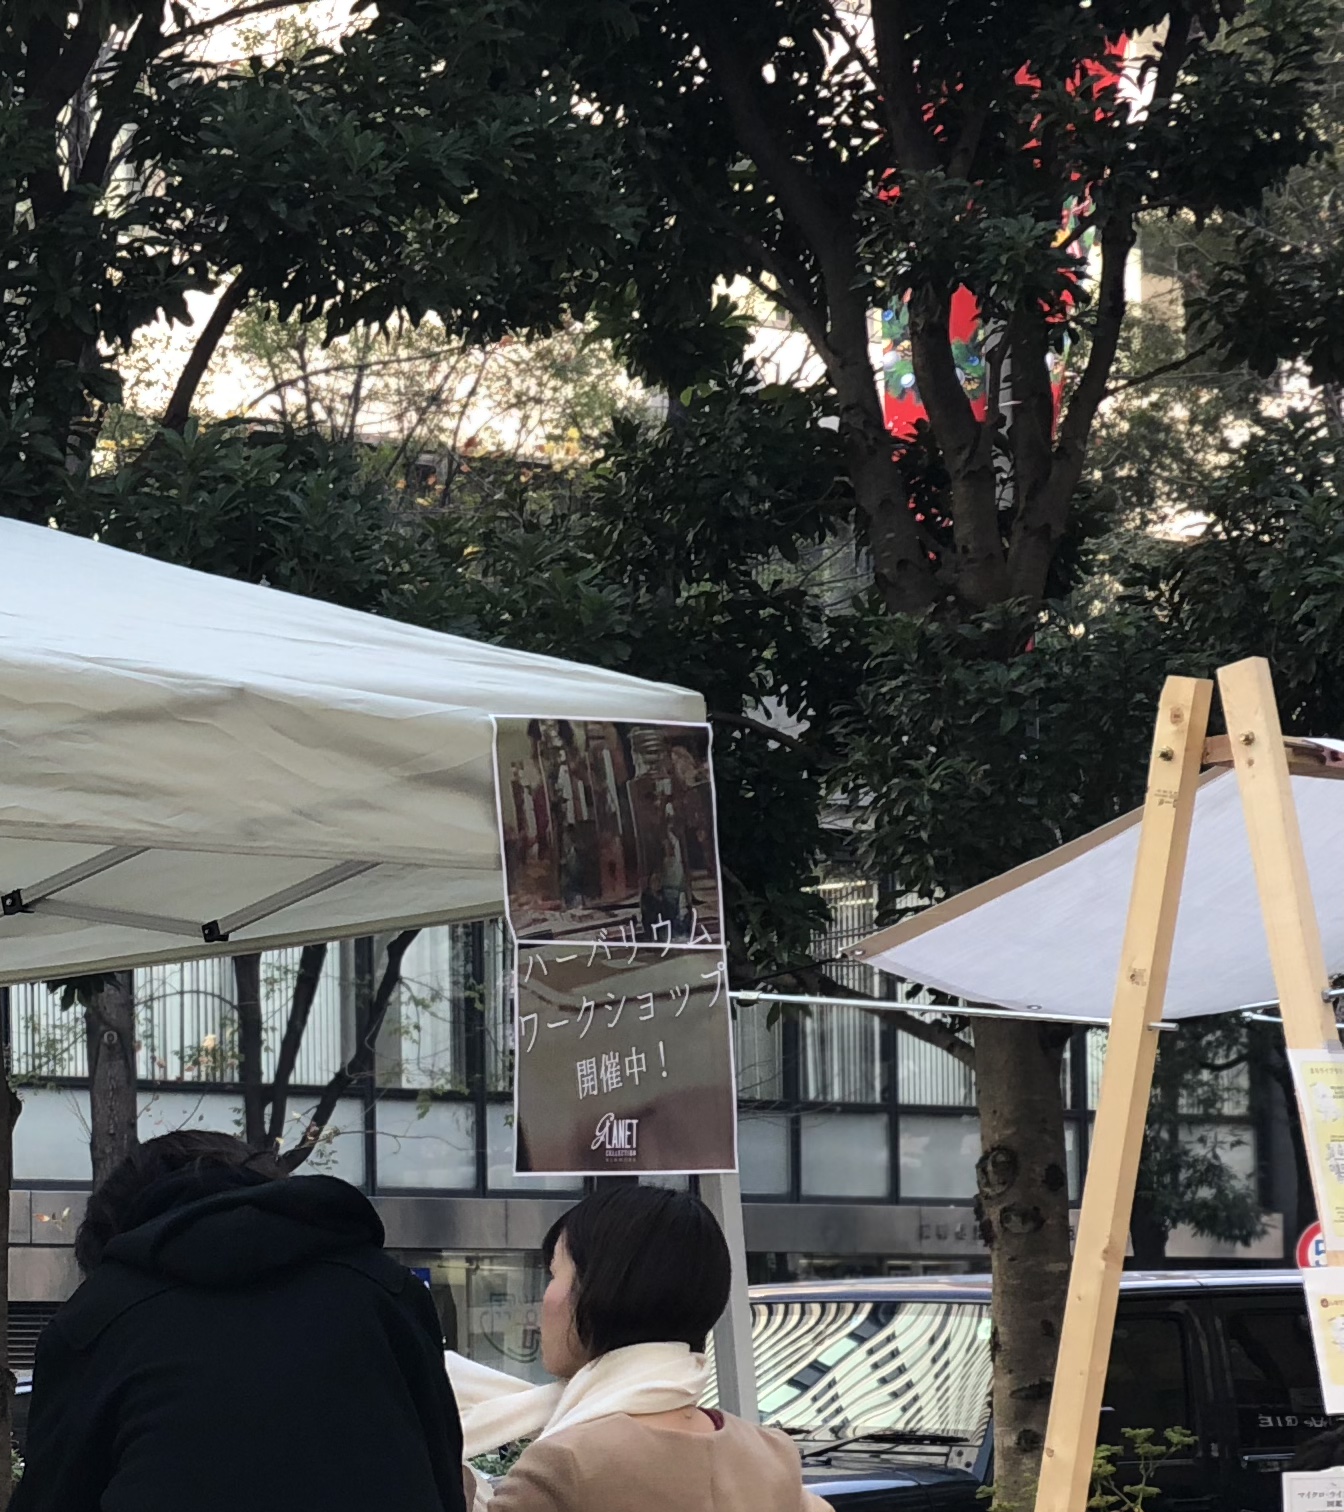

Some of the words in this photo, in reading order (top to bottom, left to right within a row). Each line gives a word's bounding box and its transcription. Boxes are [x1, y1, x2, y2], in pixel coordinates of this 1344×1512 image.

[525, 908, 712, 982] ハーバリウム
[519, 961, 725, 1053] ワークショップ
